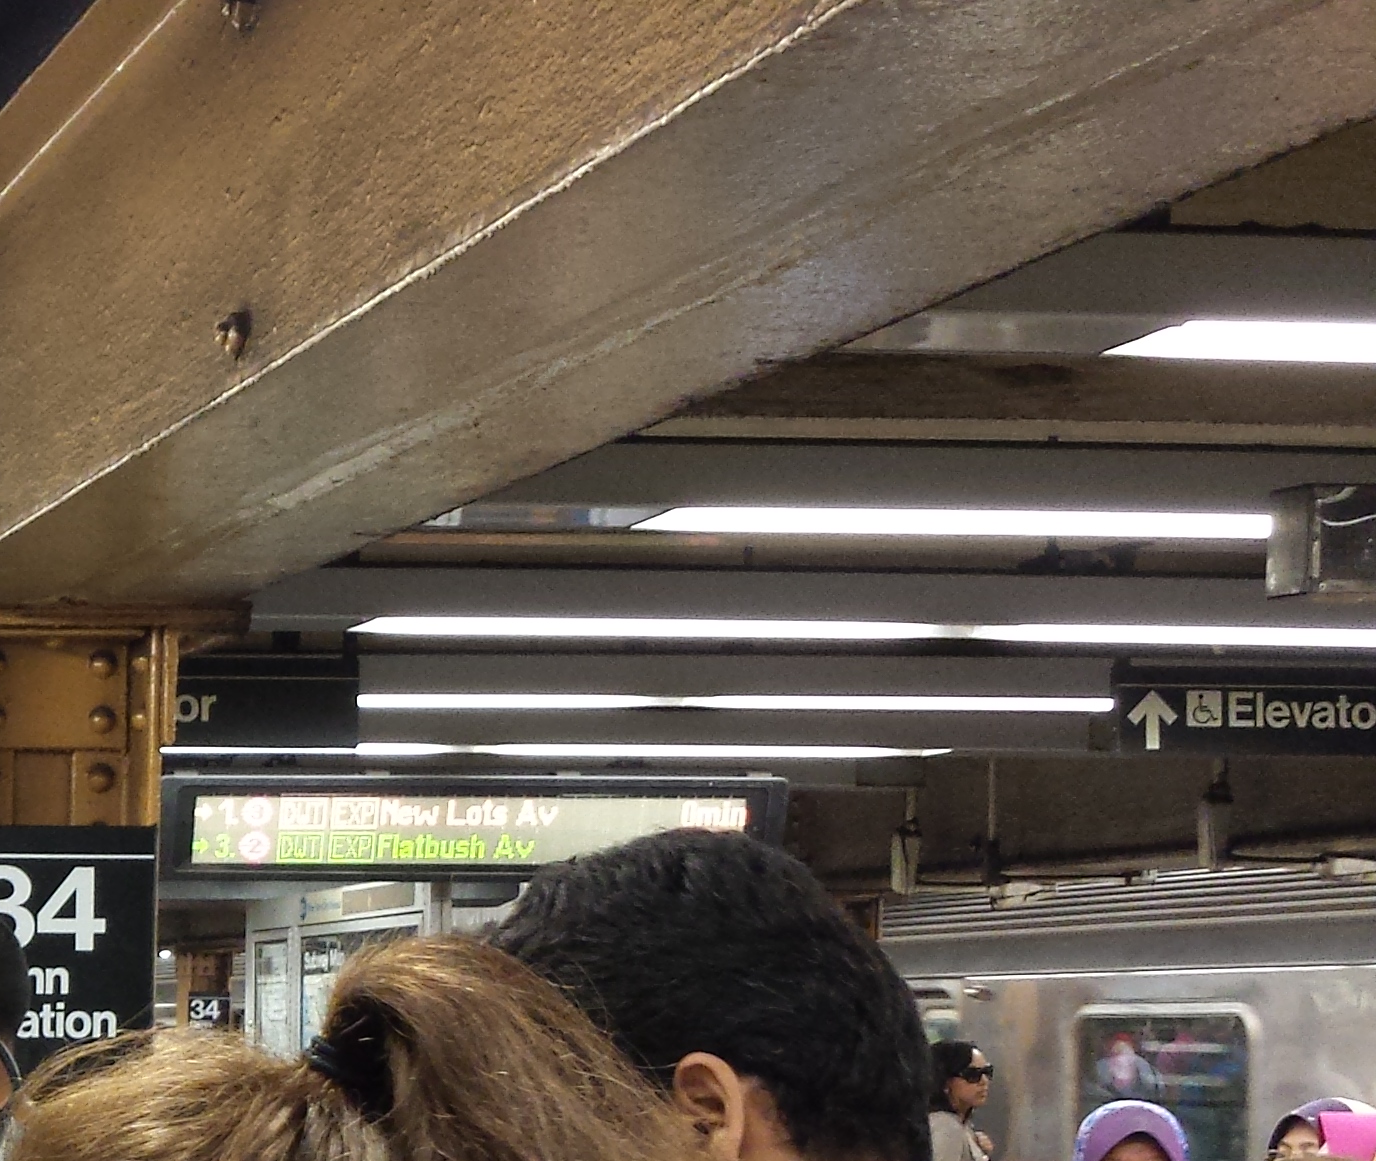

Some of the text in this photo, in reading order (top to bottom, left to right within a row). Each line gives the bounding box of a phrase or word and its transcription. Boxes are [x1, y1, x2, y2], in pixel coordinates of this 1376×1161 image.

[379, 799, 440, 827] New
[446, 799, 508, 827] Lots
[515, 799, 560, 827] Av
[333, 835, 370, 858] EXP
[377, 833, 486, 860] Flatbush
[493, 833, 536, 859] Av
[189, 999, 221, 1020] 34
